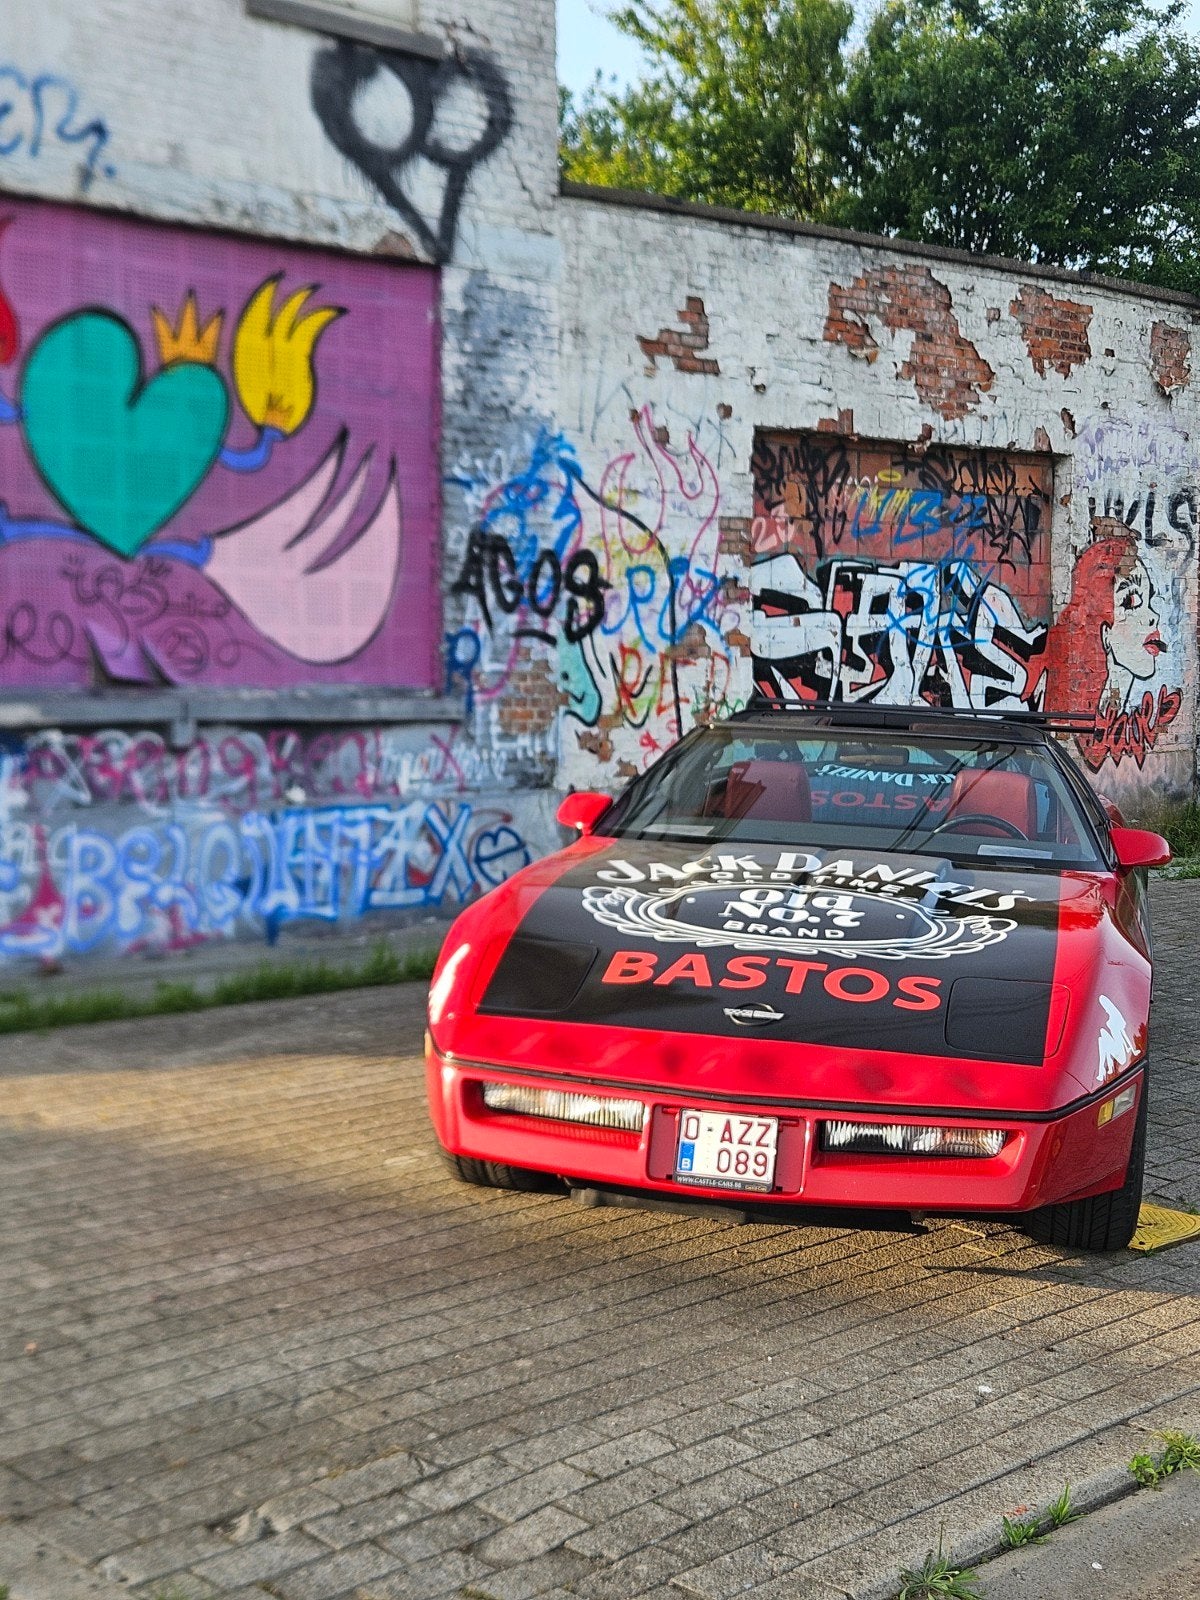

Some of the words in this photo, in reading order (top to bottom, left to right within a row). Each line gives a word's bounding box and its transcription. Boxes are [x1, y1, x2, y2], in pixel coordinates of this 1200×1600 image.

[810, 789, 951, 812] ASTOS
[596, 854, 763, 884] JACK
[774, 851, 1037, 912] DANIEL'S
[709, 870, 792, 882] OLD
[812, 874, 906, 895] TIME
[722, 920, 846, 939] BRAND
[601, 950, 942, 1012] BASTOS
[716, 1147, 768, 1177] 089
